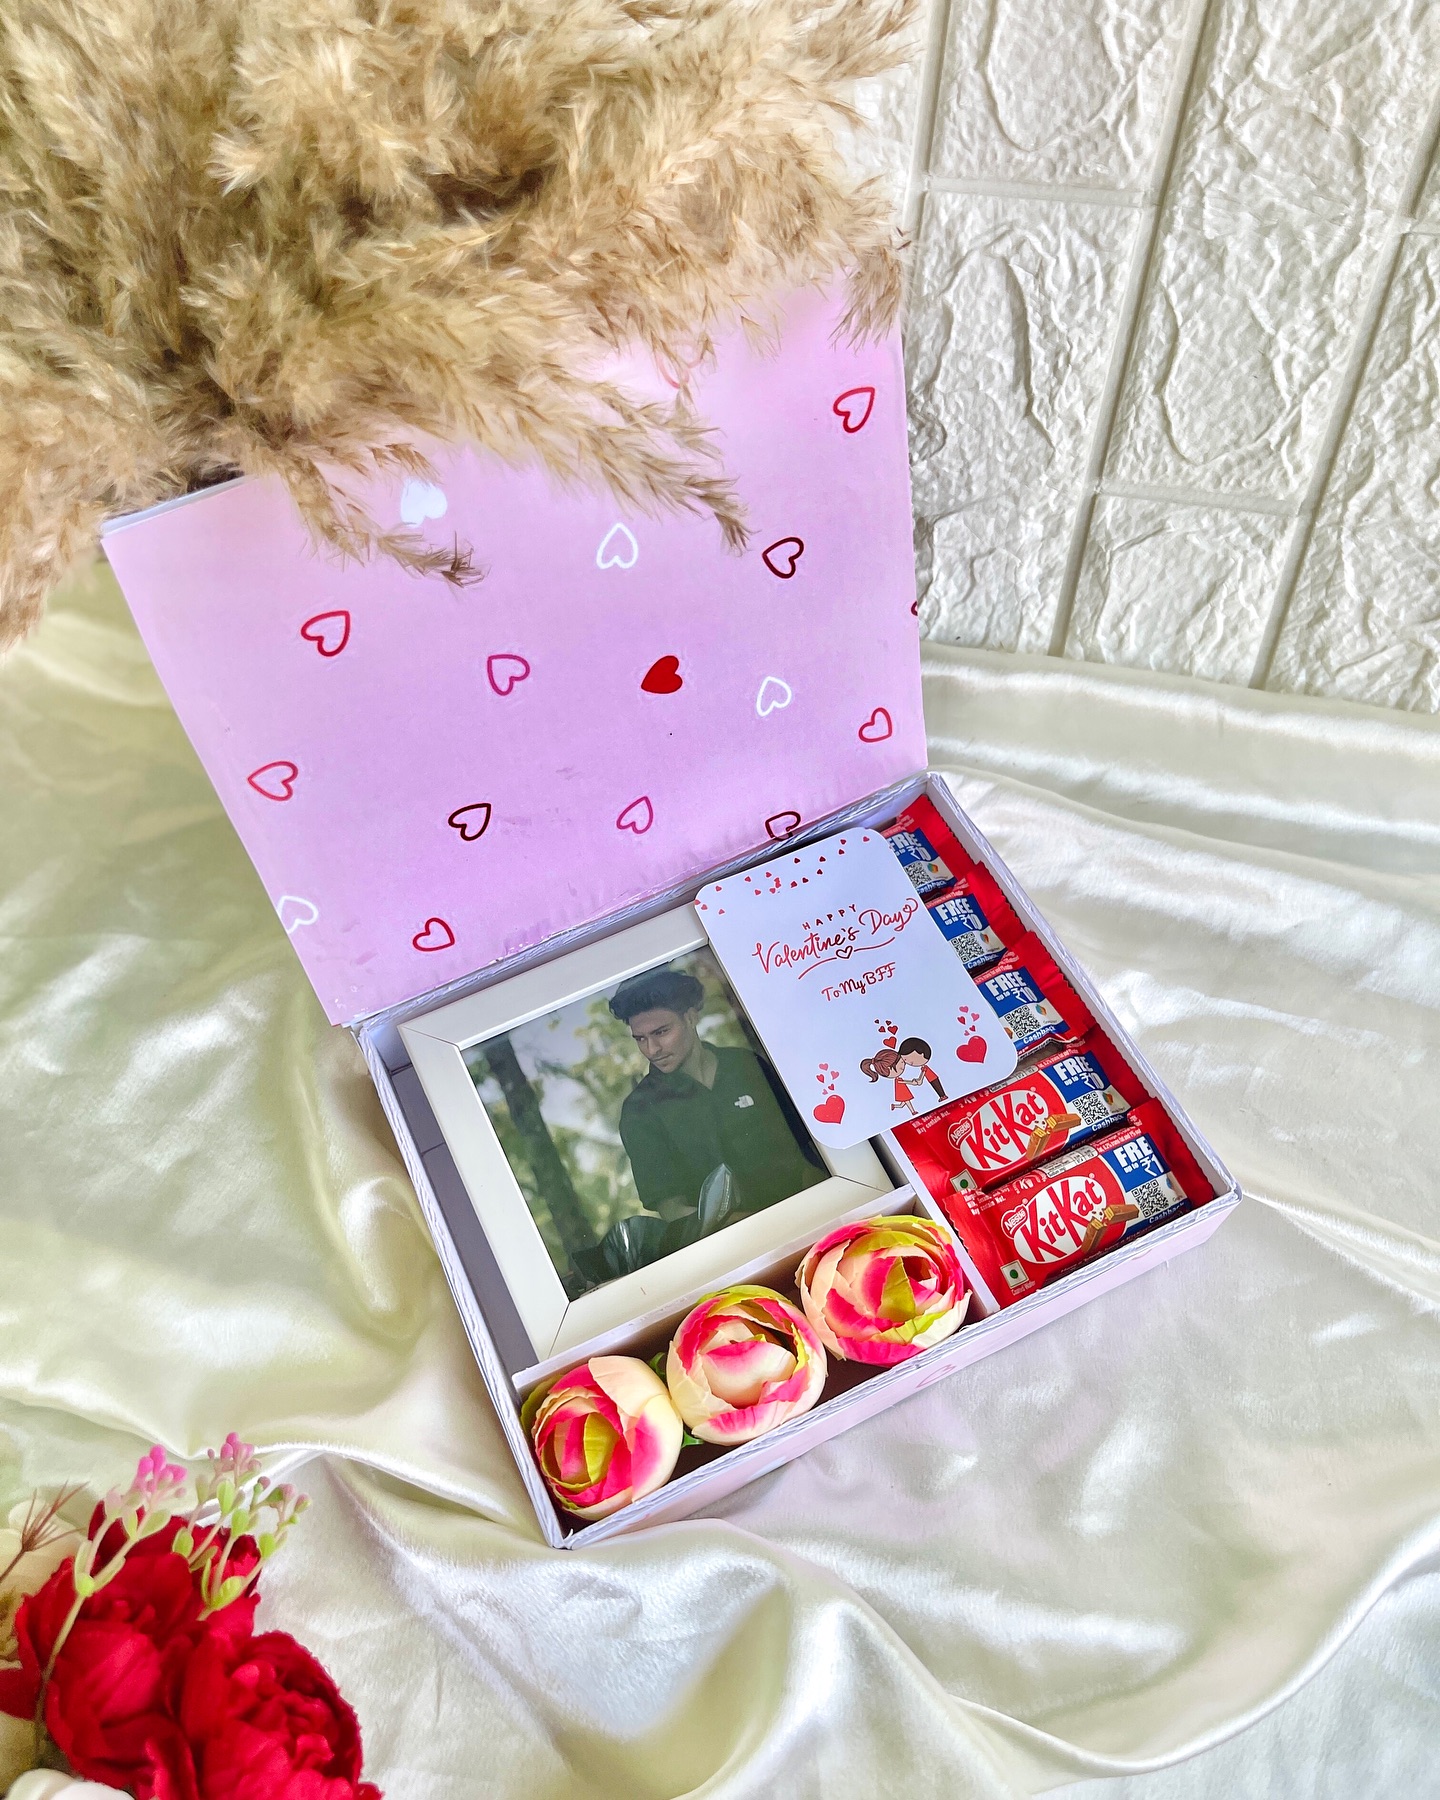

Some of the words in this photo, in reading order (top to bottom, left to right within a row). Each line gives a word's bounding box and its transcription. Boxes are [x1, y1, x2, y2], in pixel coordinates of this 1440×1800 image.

[802, 904, 857, 930] HAPPY
[934, 897, 974, 923] FREE
[959, 913, 982, 931] ₹10
[752, 927, 859, 973] Valentine's
[859, 898, 918, 935] Day
[822, 987, 840, 1001] To
[840, 979, 866, 994] My
[863, 962, 895, 985] BFF
[984, 971, 1027, 997] FREE
[1011, 986, 1038, 1004] ₹10
[1053, 1056, 1094, 1082] FREE
[1079, 1072, 1105, 1090] ₹10
[965, 1092, 1044, 1169] KitKat
[1113, 1135, 1153, 1168] FRE
[1123, 1165, 1133, 1174] up
[1131, 1162, 1139, 1170] to
[1140, 1153, 1164, 1177] ₹1
[1020, 1180, 1103, 1262] KitKat
